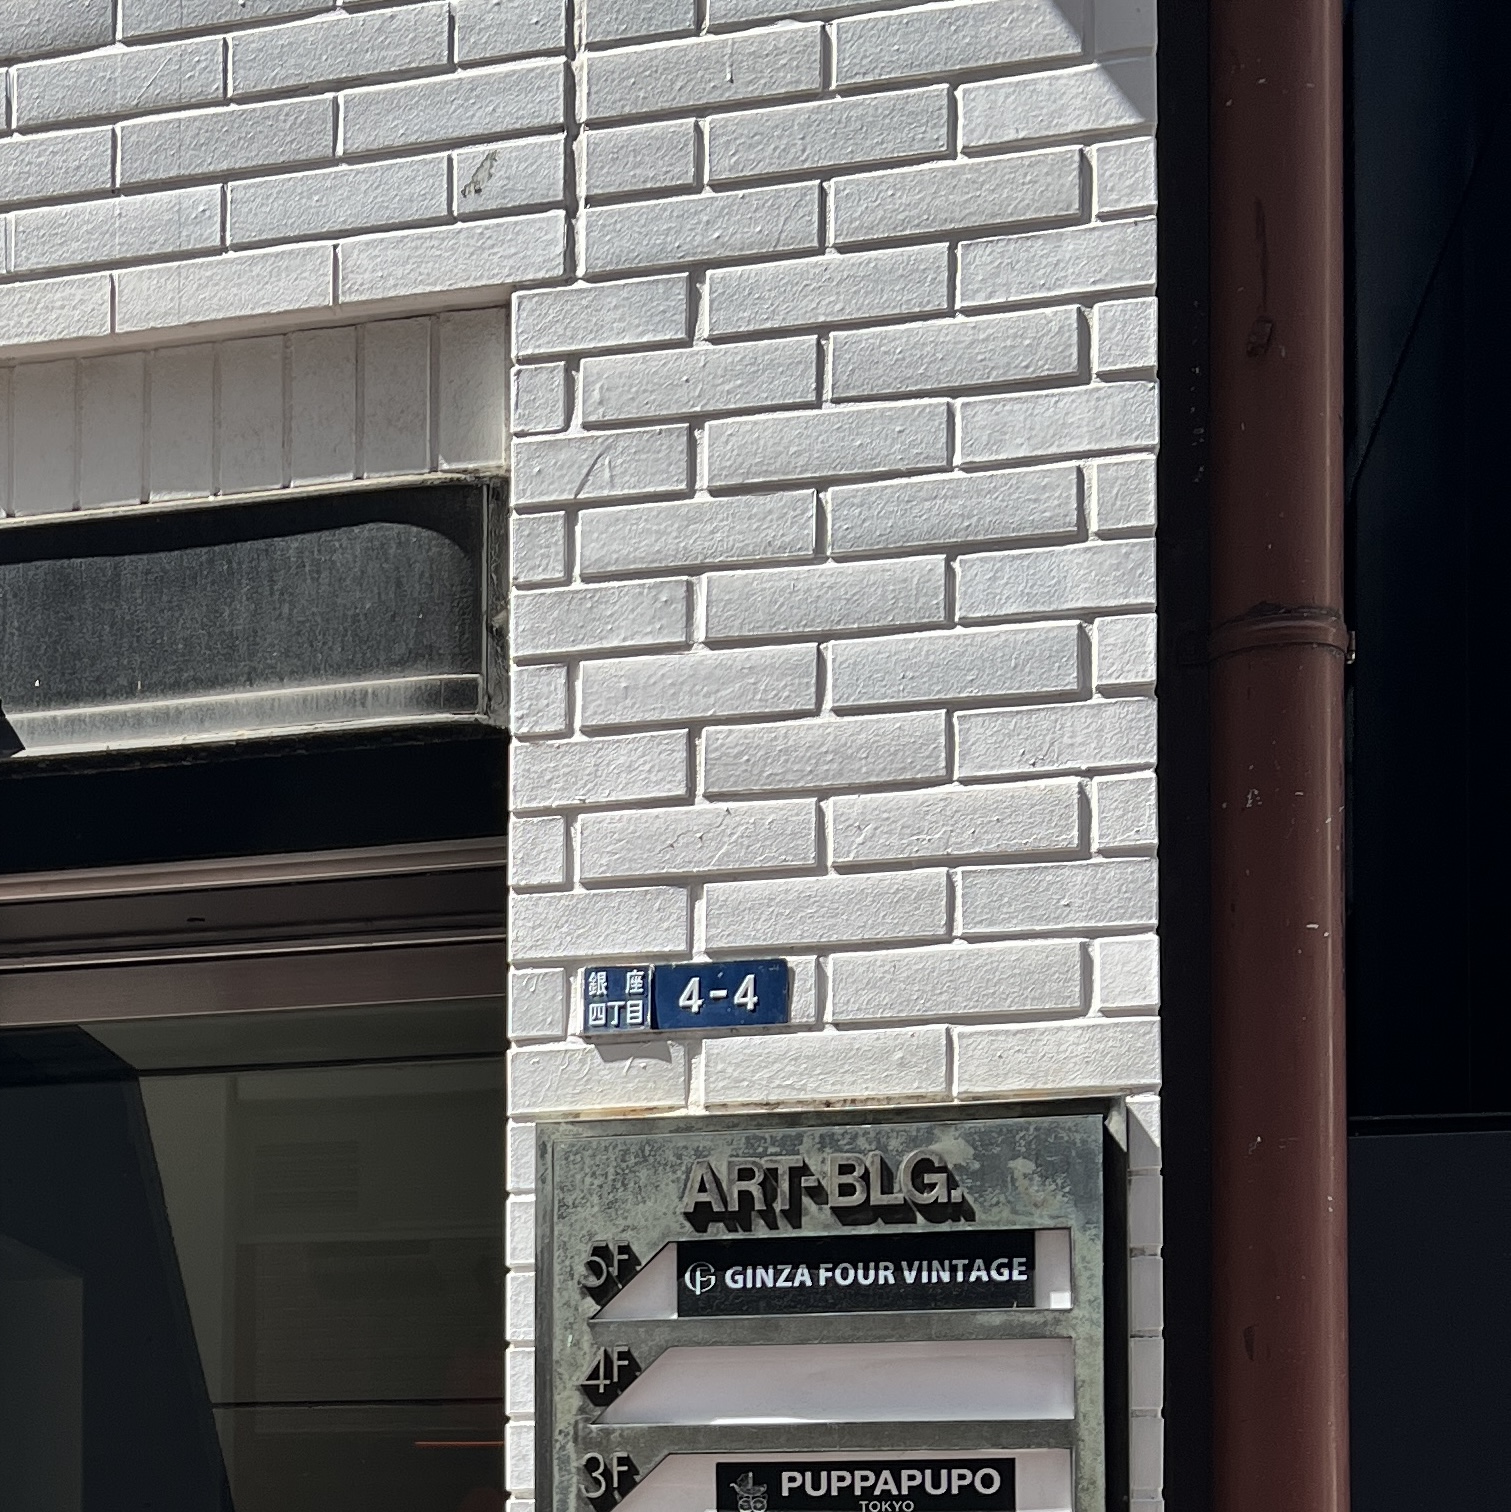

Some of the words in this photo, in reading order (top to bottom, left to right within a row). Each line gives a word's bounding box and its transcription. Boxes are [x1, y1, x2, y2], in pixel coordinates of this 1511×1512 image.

[678, 974, 758, 1013] 4-4
[588, 1000, 643, 1027] 四丁目
[578, 1240, 629, 1288] 5F
[724, 1264, 813, 1290] GINZA
[819, 1262, 896, 1287] FOUR
[901, 1257, 1028, 1284] VINTAGE
[576, 1346, 629, 1393] 4F
[580, 1452, 628, 1498] 3F
[781, 1468, 1001, 1497] PUPPAPUPO
